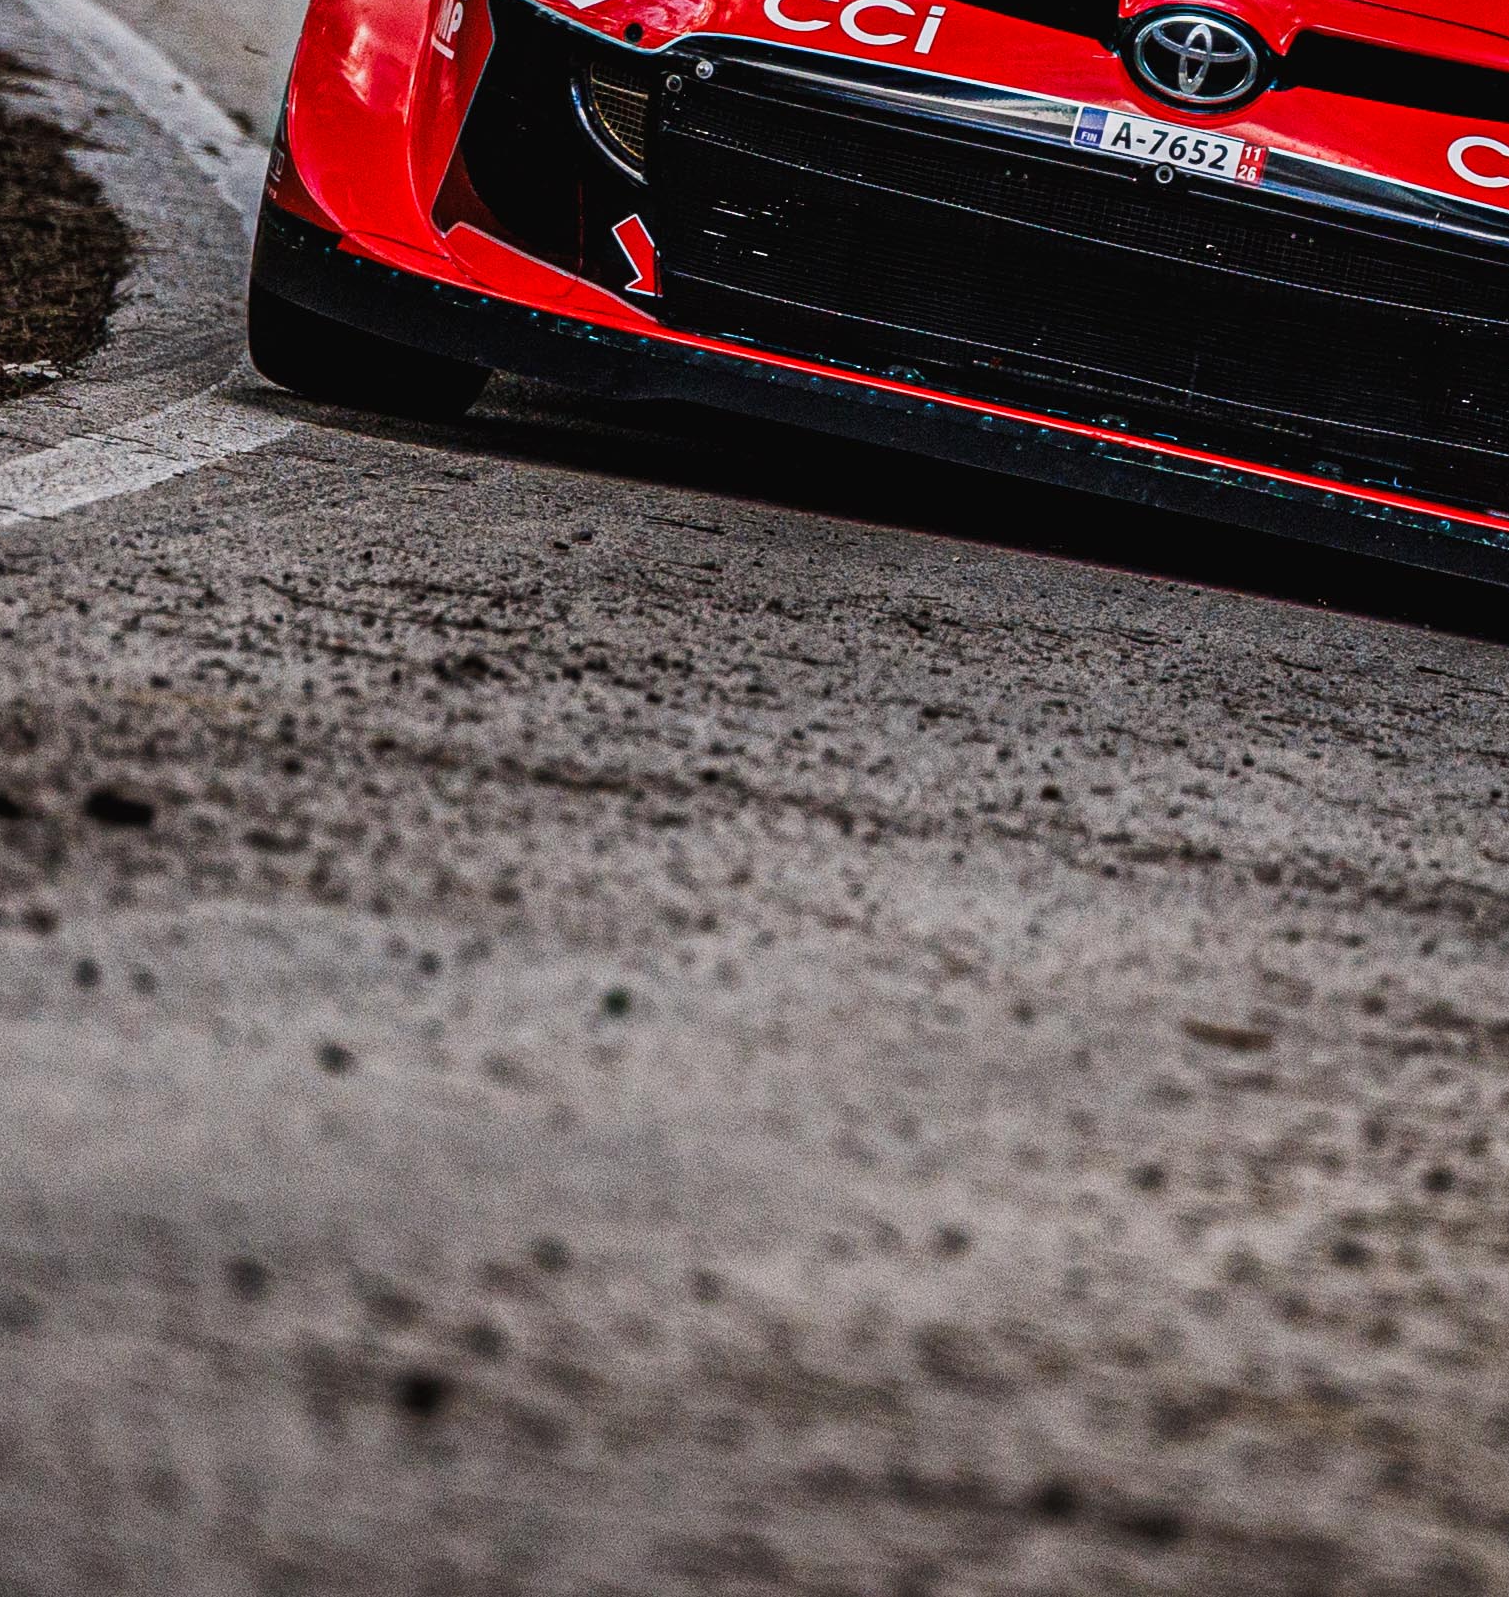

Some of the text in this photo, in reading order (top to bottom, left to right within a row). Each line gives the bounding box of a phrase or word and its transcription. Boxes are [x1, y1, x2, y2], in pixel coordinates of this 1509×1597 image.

[1080, 121, 1229, 172] FIN A-7652
[1244, 146, 1262, 162] 11
[1237, 164, 1258, 182] 26
